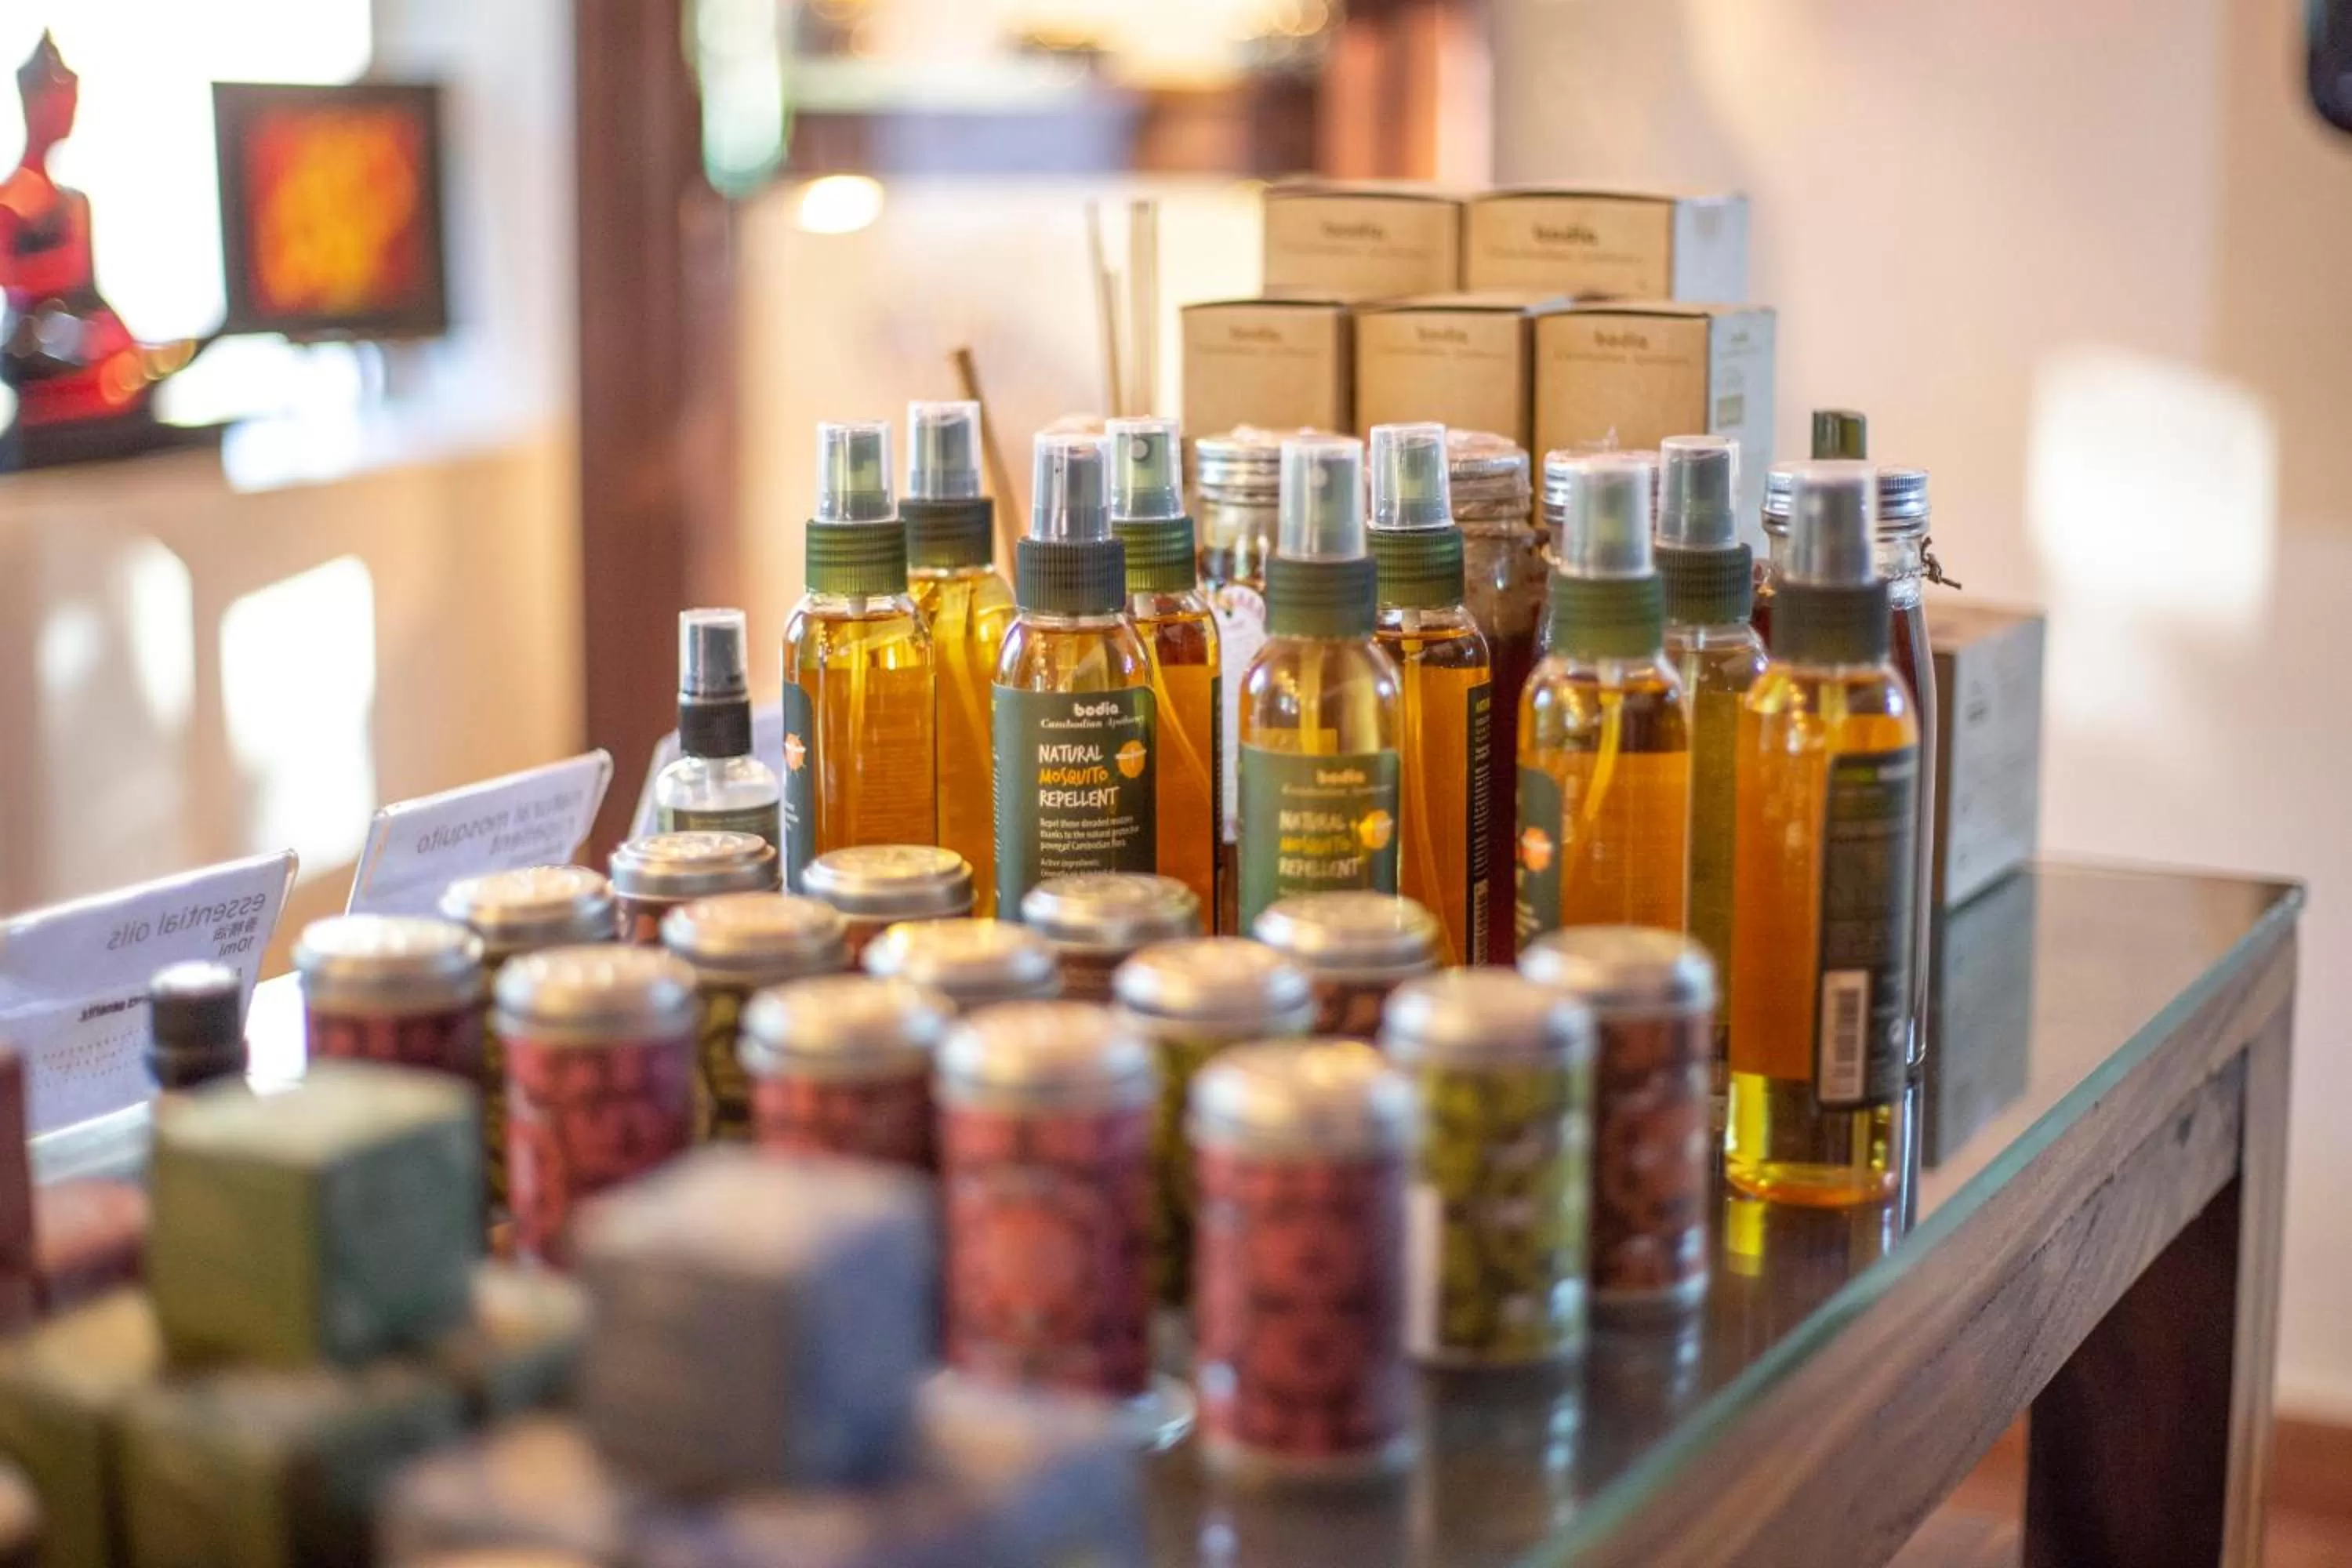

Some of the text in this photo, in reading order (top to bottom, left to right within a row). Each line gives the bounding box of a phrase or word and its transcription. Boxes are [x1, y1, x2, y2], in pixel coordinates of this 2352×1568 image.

[1073, 702, 1119, 717] bodia
[1039, 743, 1104, 764] NATURAL
[1040, 786, 1121, 809] REPELLENT
